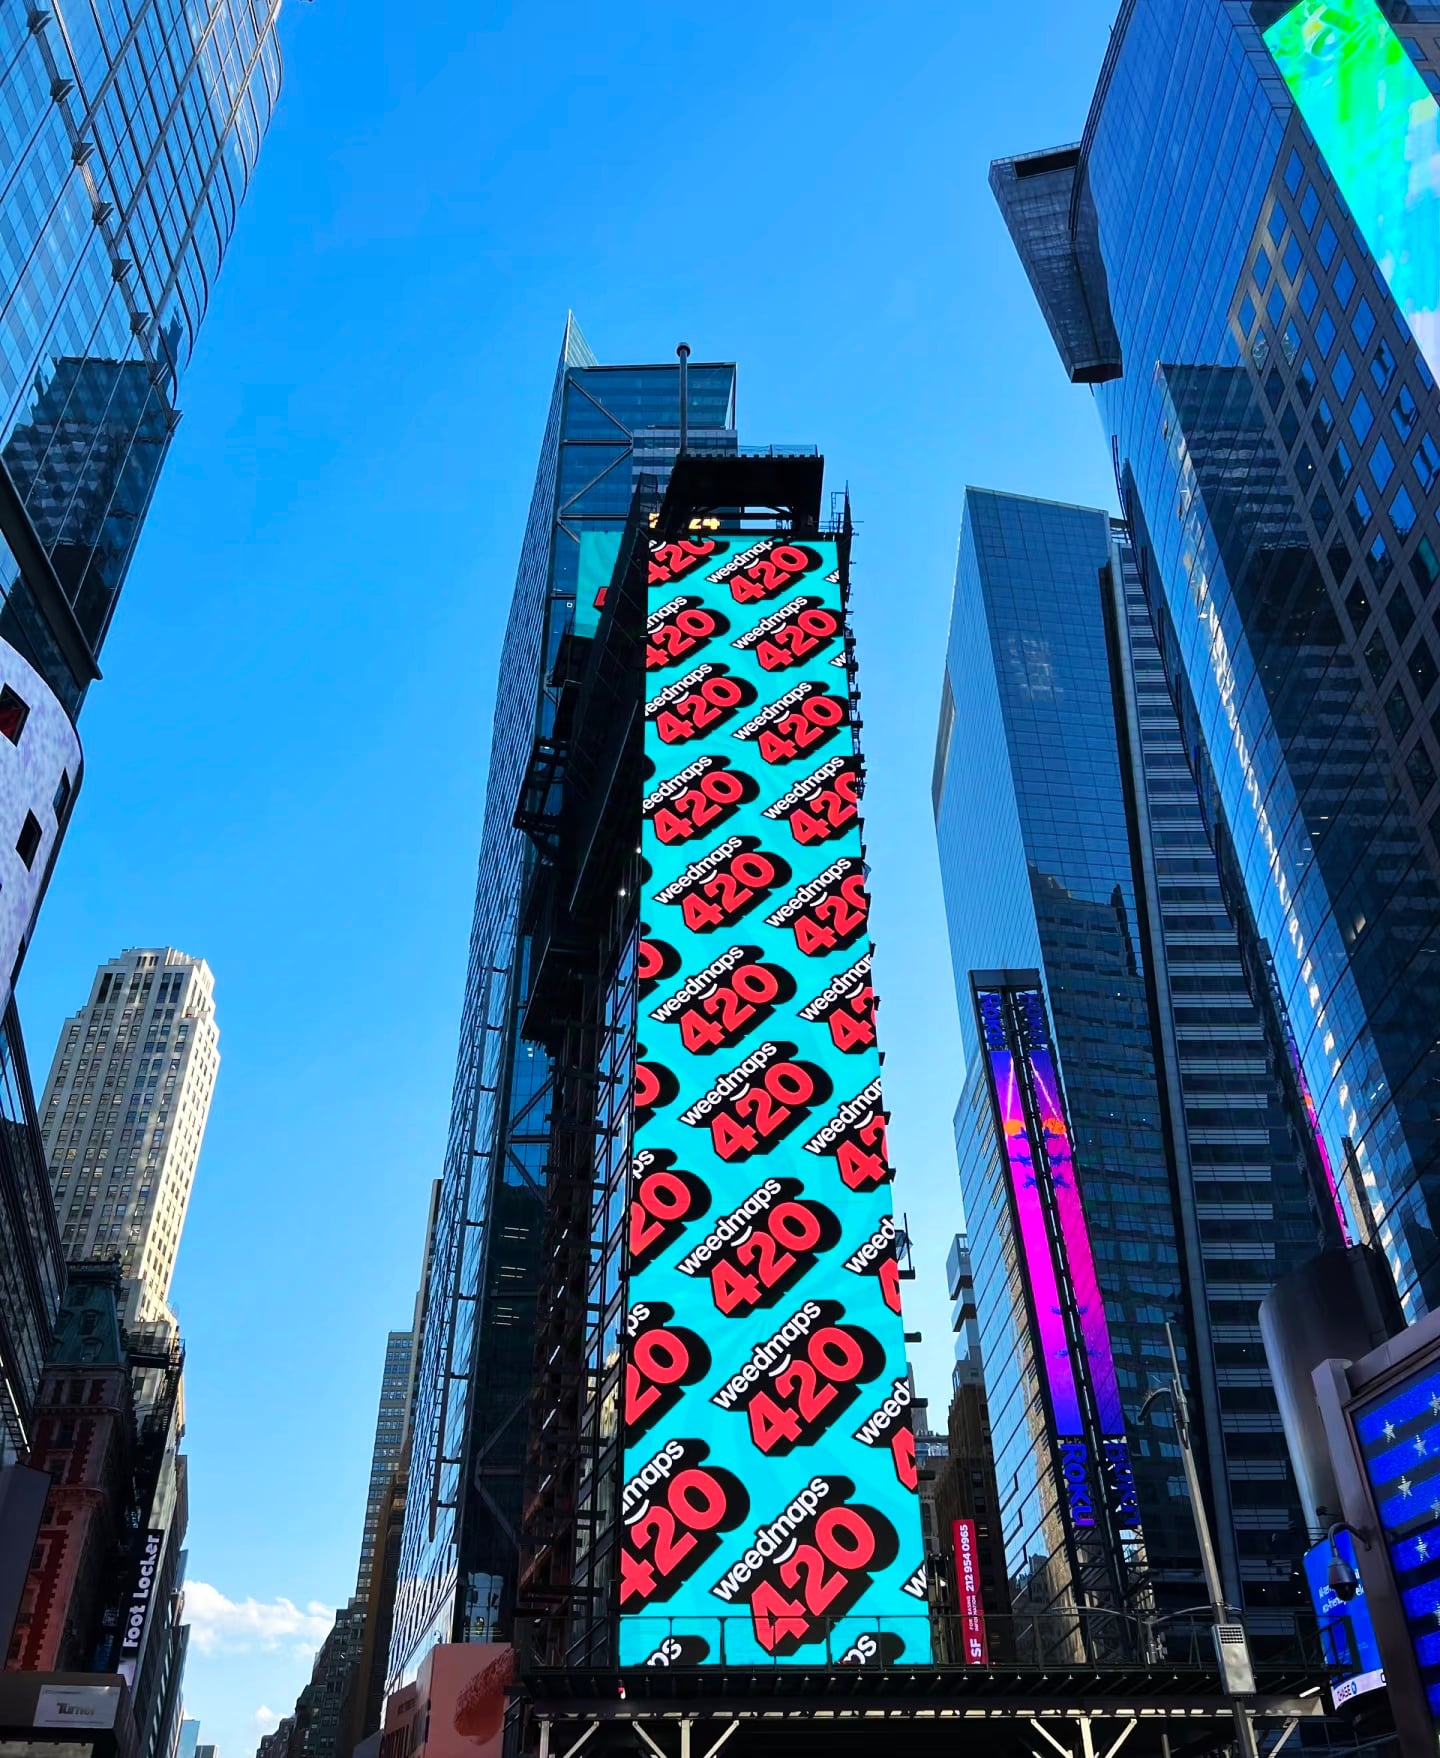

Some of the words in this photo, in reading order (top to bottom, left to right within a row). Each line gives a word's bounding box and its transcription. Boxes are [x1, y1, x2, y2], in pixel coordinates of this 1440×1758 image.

[730, 546, 809, 603] 420
[733, 598, 808, 649] weedmaps
[757, 610, 837, 670] 420
[657, 678, 742, 743] 420
[734, 683, 812, 740] weedmaps
[759, 696, 843, 763] 420
[643, 757, 713, 814] eedmaps
[654, 771, 744, 846] 420
[764, 758, 845, 819] weedmaps
[655, 837, 743, 904] weedmaps
[683, 853, 775, 931] 420
[767, 859, 852, 927] weedmaps
[651, 947, 744, 1022] weedmaps
[681, 965, 779, 1053] 420
[681, 1043, 777, 1126] weedmaps
[712, 1063, 814, 1160] 420
[679, 1180, 782, 1275] weedmaps
[712, 1202, 821, 1314] 420
[714, 1302, 821, 1409] weedmaps
[749, 1328, 864, 1452] 420
[622, 1441, 684, 1525] maps
[1060, 1443, 1095, 1526] ROKU
[132, 1534, 160, 1598] Locker
[713, 1478, 830, 1601] weedmaps
[960, 1524, 970, 1551] 0965
[963, 1552, 973, 1573] 954
[752, 1507, 876, 1651] 420
[965, 1573, 975, 1592] 212
[123, 1605, 146, 1649] Foot
[970, 1638, 982, 1658] SF
